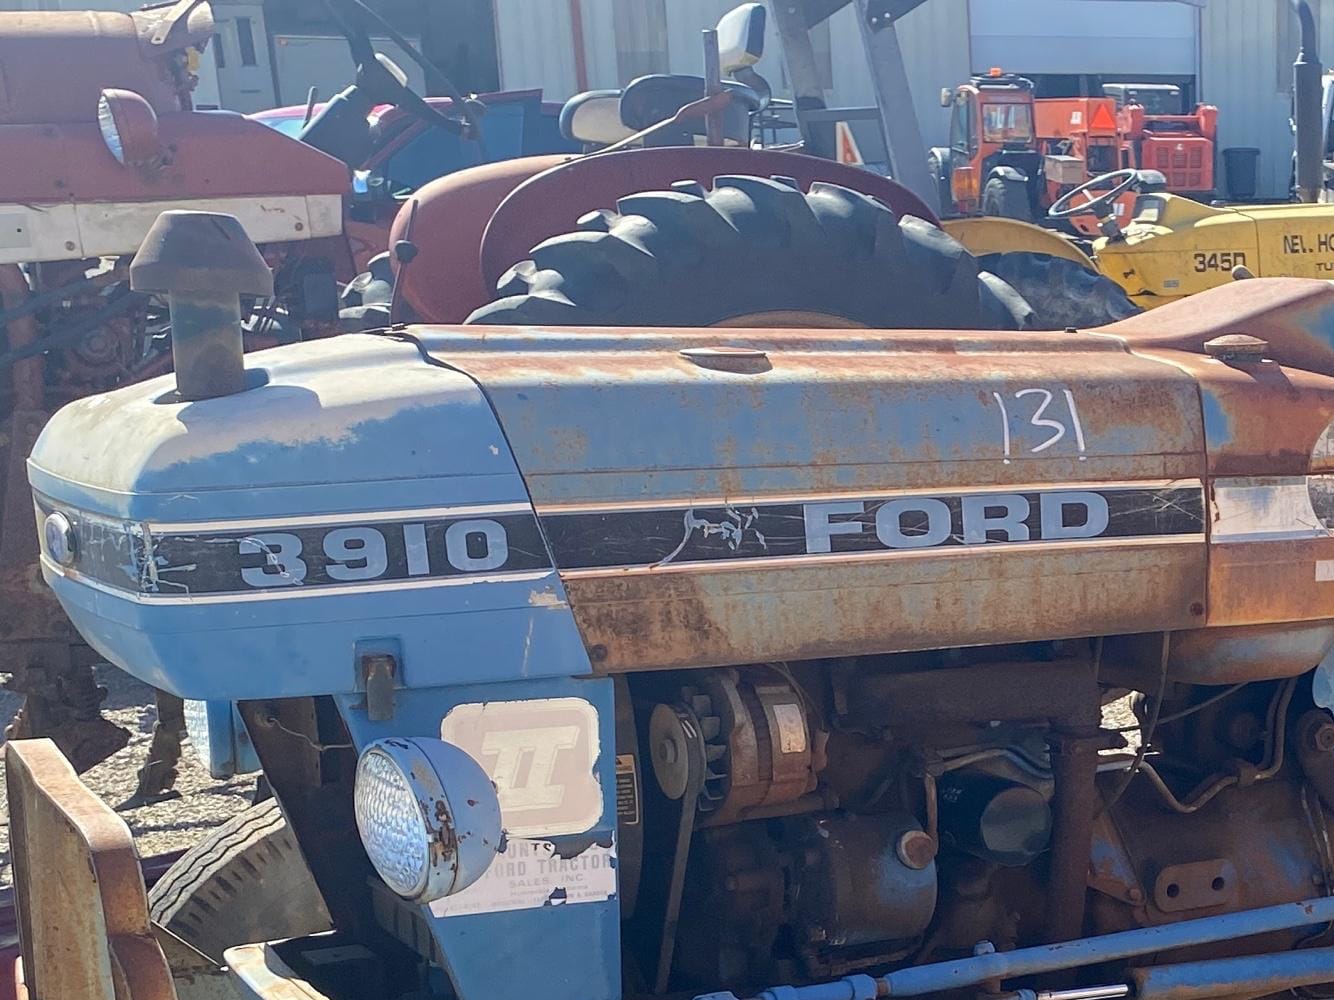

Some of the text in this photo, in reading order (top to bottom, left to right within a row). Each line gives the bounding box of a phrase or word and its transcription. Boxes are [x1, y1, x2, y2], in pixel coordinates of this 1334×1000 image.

[1194, 252, 1246, 273] 345D
[993, 388, 1086, 464] 131
[239, 519, 508, 587] 3910
[803, 491, 1109, 554] FORD
